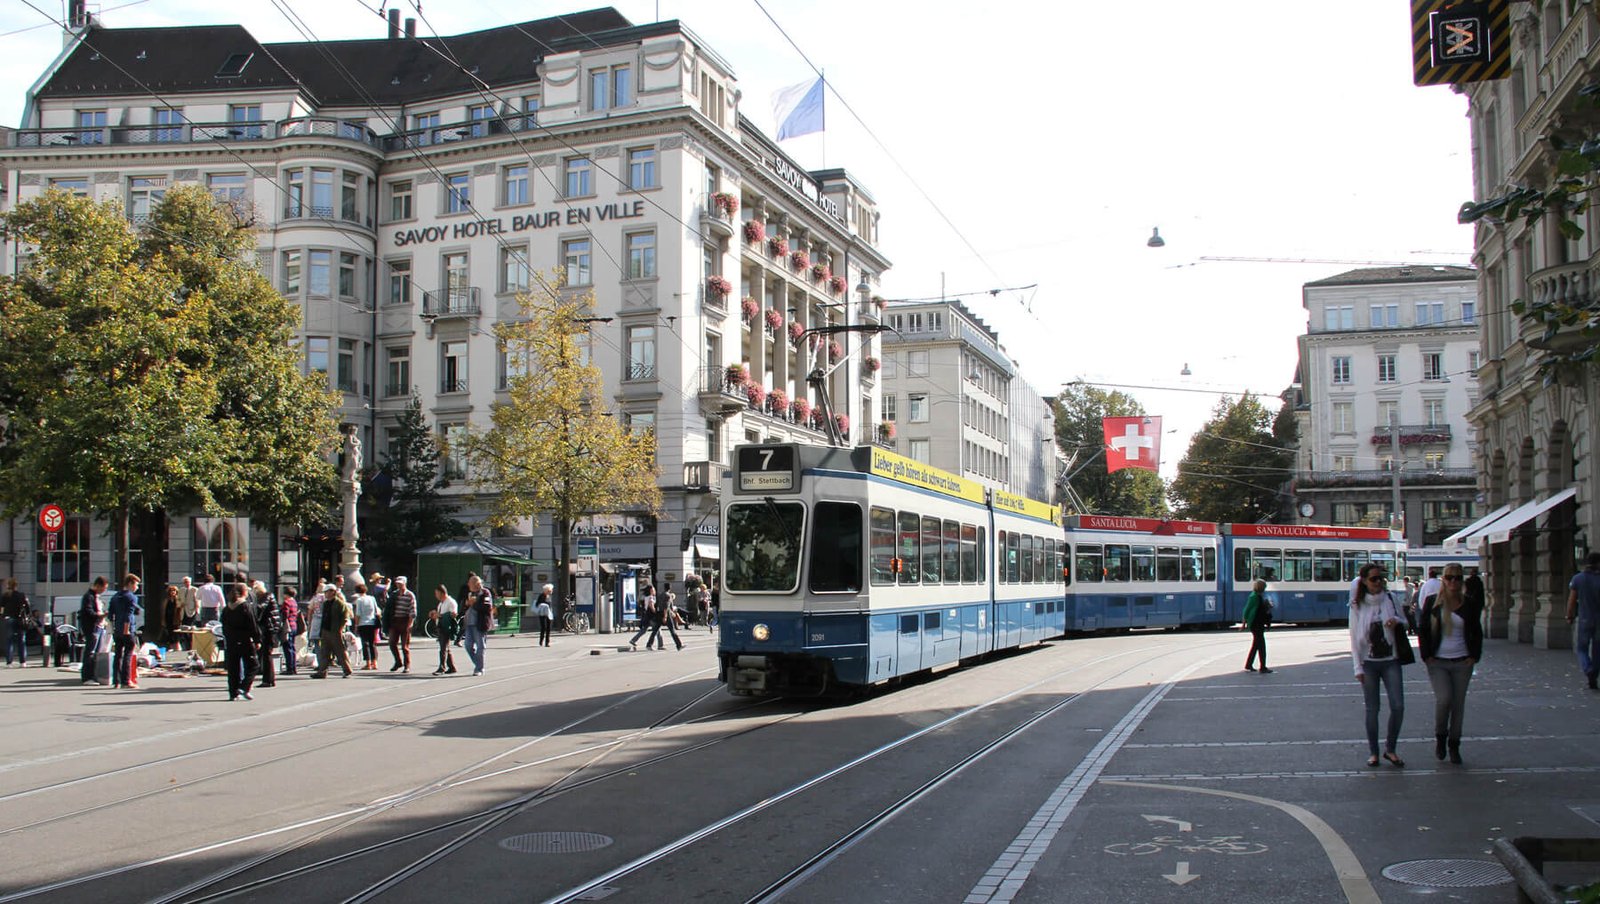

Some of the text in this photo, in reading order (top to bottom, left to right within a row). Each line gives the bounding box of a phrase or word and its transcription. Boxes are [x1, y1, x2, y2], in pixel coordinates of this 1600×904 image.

[775, 157, 842, 220] SAVOY HOTEL
[394, 200, 645, 247] SAVOY HOTEL BAUR EN VILLE
[759, 449, 774, 471] 7
[874, 452, 893, 473] Lieber
[696, 525, 719, 536] MARS
[1090, 517, 1137, 529] SANTA LUCIA
[1256, 526, 1283, 535] SANTA
[1284, 528, 1308, 536] LUCIA
